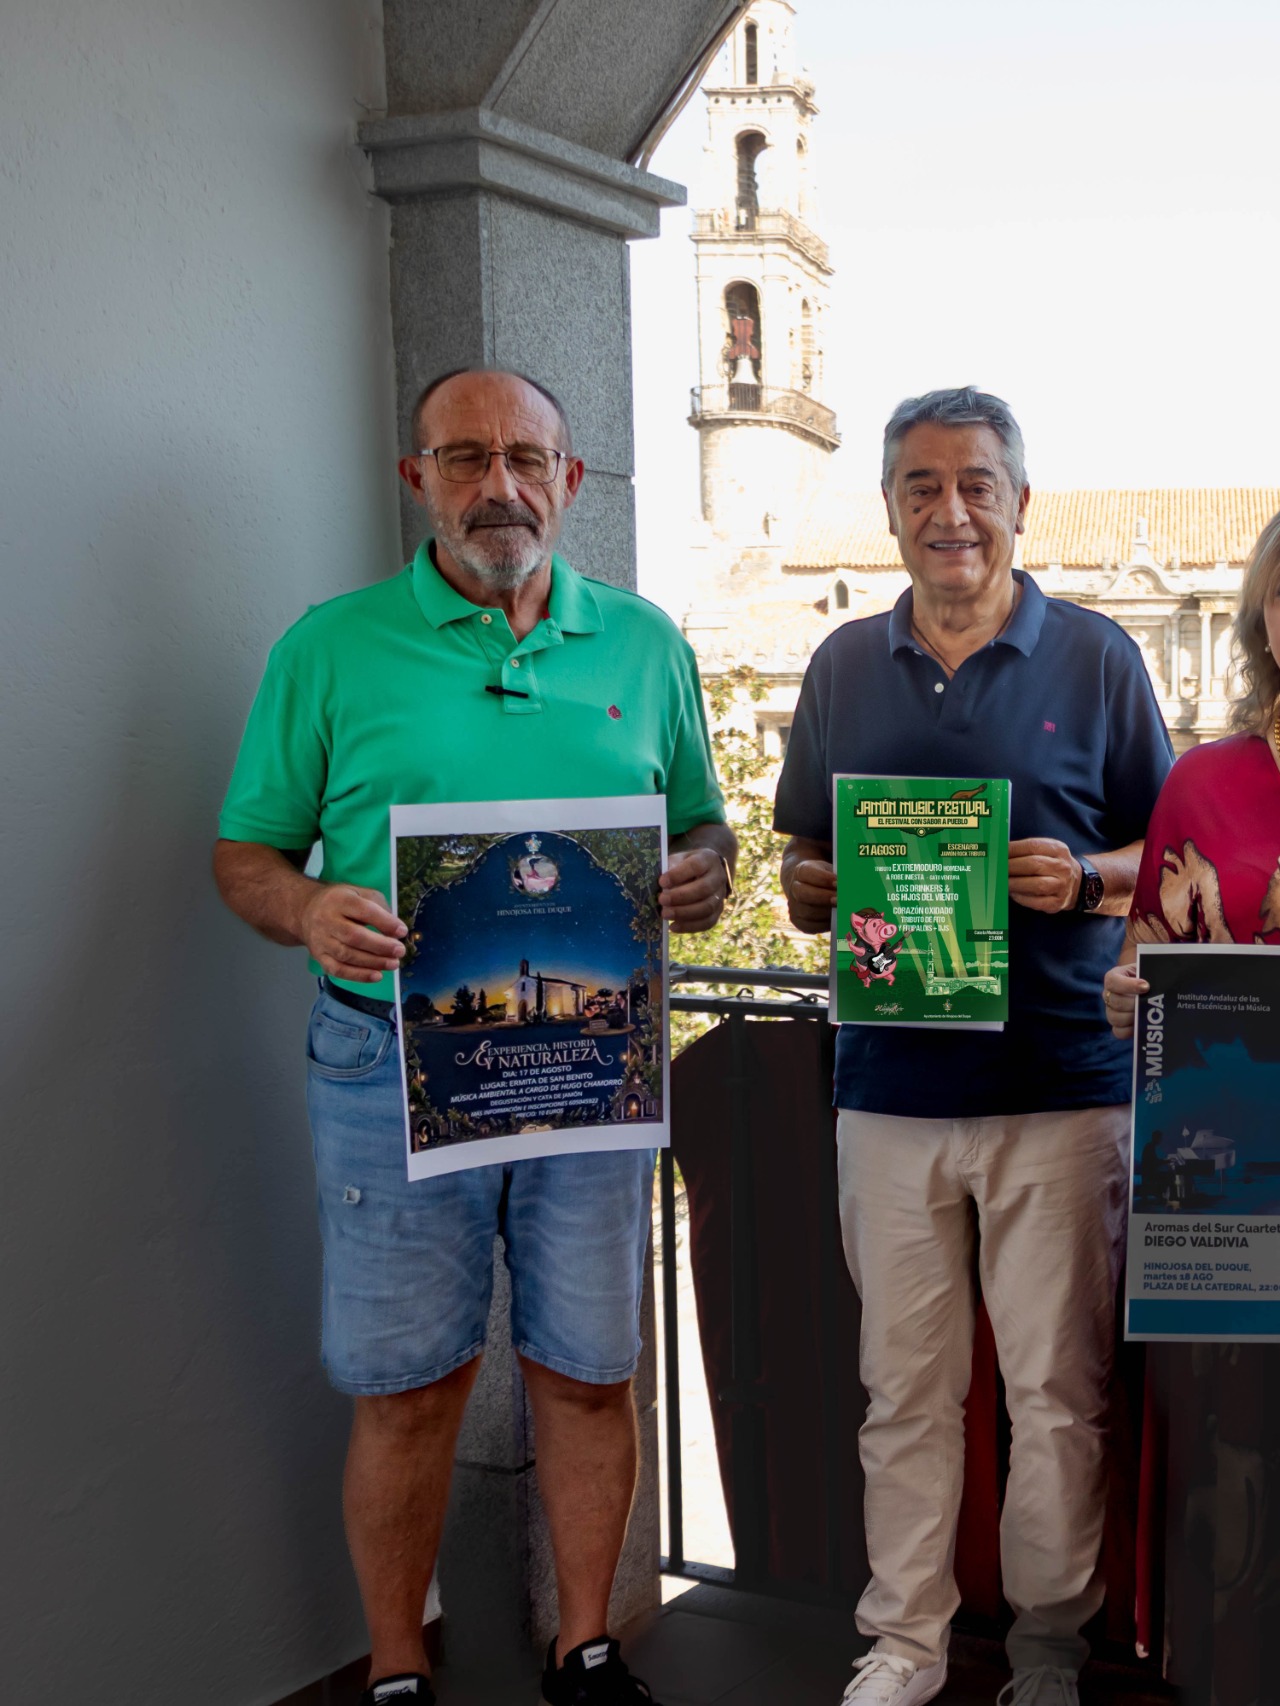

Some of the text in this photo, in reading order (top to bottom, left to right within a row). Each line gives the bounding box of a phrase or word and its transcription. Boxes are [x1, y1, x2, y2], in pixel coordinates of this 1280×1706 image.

[856, 798, 990, 815] JAMÓN MUSIC FESTIVAL
[859, 844, 907, 856] 21 AGOSTO
[892, 864, 942, 872] EXTREMODURO
[896, 884, 950, 892] LOS DRINKERS &
[887, 893, 959, 901] LOS HIJOS DEL VIENTO
[893, 905, 924, 915] CORAZÓN
[1209, 994, 1237, 1002] Andaluz
[1197, 1002, 1231, 1010] Escénicas
[1246, 1004, 1271, 1012] Música
[1142, 994, 1164, 1076] MÚSICA
[553, 1039, 596, 1050] HISTORIA
[498, 1047, 614, 1069] NATURALEZA
[502, 1065, 572, 1078] DIA: 17 DE AGOSTO
[480, 1072, 594, 1090] LUGAR: ERMITA DE SAN BENITO
[450, 1093, 478, 1104] MÚSICA
[478, 1089, 517, 1099] AMBIENTAL
[525, 1085, 549, 1094] CARGO
[550, 1084, 560, 1092] DE
[561, 1081, 582, 1090] HUGO
[583, 1078, 623, 1088] CHAMORRO
[490, 1096, 532, 1106] DEGUSTACIÓN
[1144, 1222, 1190, 1232] Aromas
[1192, 1223, 1212, 1233] del
[1214, 1223, 1234, 1233] Sur
[1144, 1236, 1249, 1248] DIEGO VALDIVIA
[1144, 1262, 1252, 1272] HINOJOSA DEL DUQUE,
[1192, 1273, 1213, 1281] AGO
[1143, 1282, 1173, 1290] PLAZA
[1191, 1283, 1203, 1291] LA
[1204, 1283, 1257, 1292] CATEDRAL,
